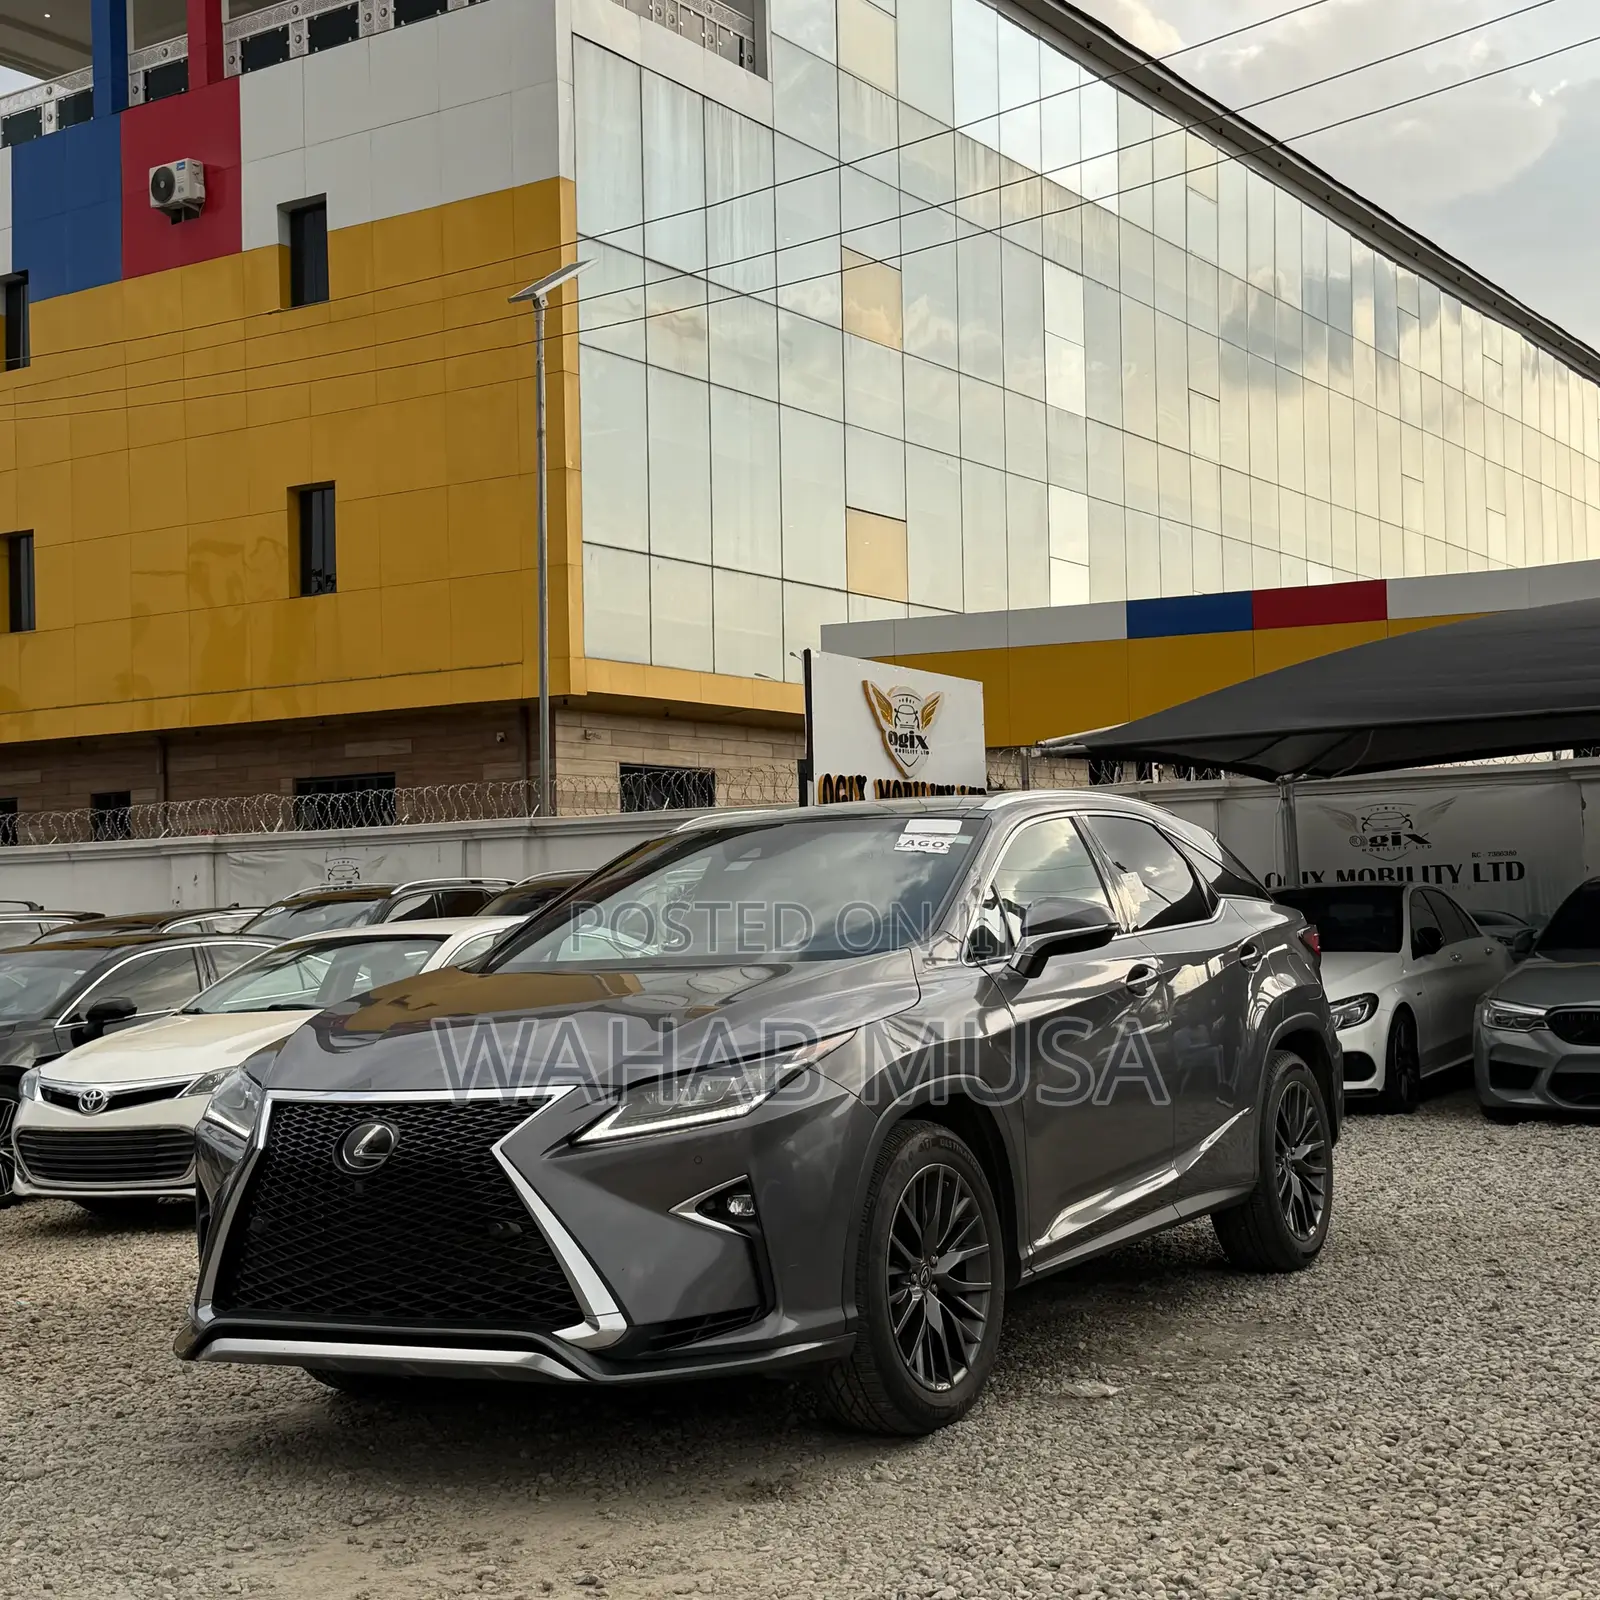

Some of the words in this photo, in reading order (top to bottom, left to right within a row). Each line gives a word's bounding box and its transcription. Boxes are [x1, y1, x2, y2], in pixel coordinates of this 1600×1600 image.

[1264, 871, 1325, 888] OIX
[1336, 863, 1462, 884] MOBILITY
[1472, 861, 1526, 882] LTD
